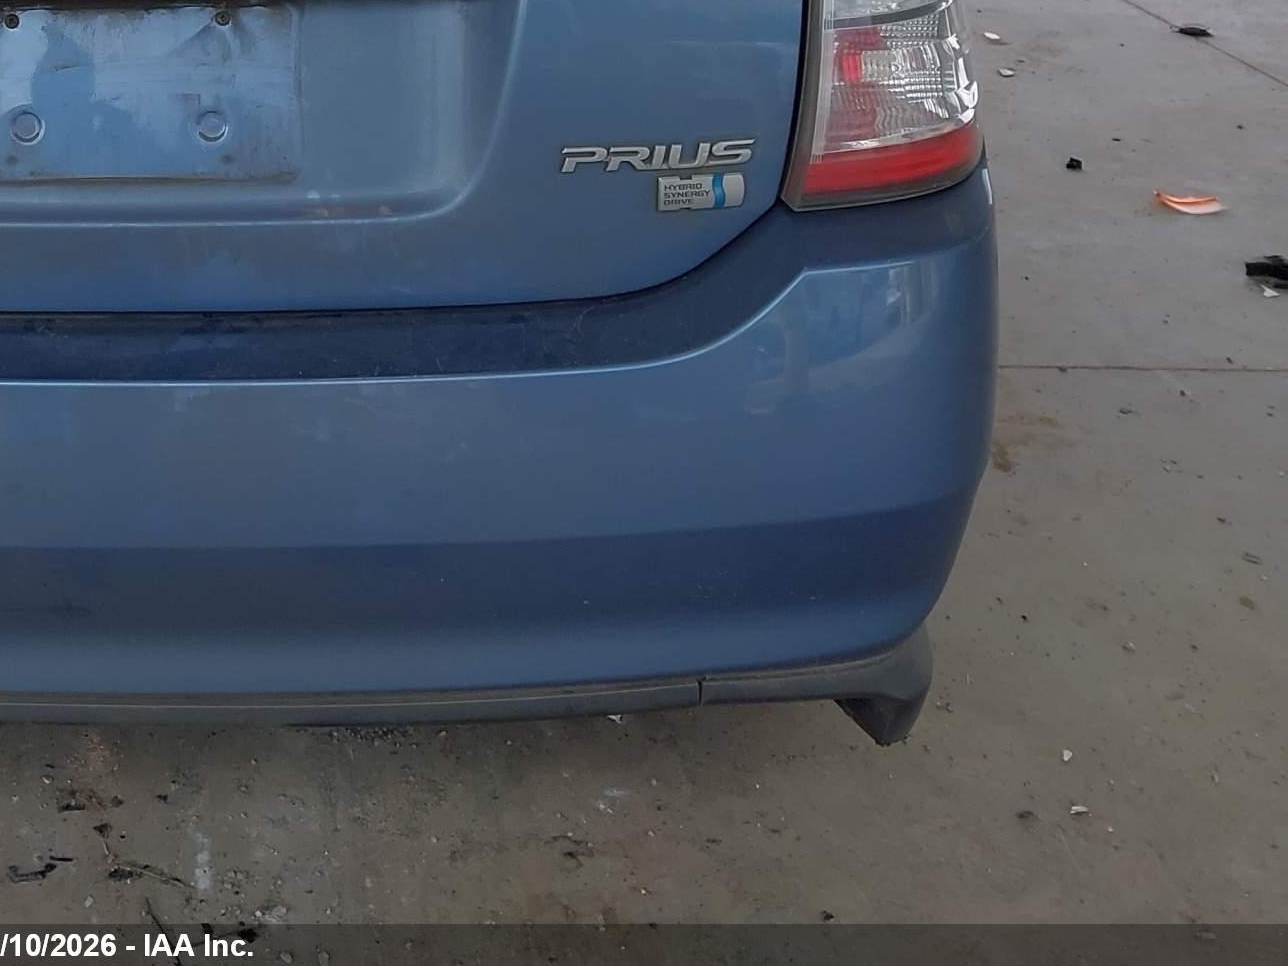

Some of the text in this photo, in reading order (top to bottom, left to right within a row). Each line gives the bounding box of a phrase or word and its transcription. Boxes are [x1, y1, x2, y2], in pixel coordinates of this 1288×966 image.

[561, 138, 756, 173] PRIUS
[663, 183, 703, 191] HYBRID
[663, 190, 711, 199] SYNERGY
